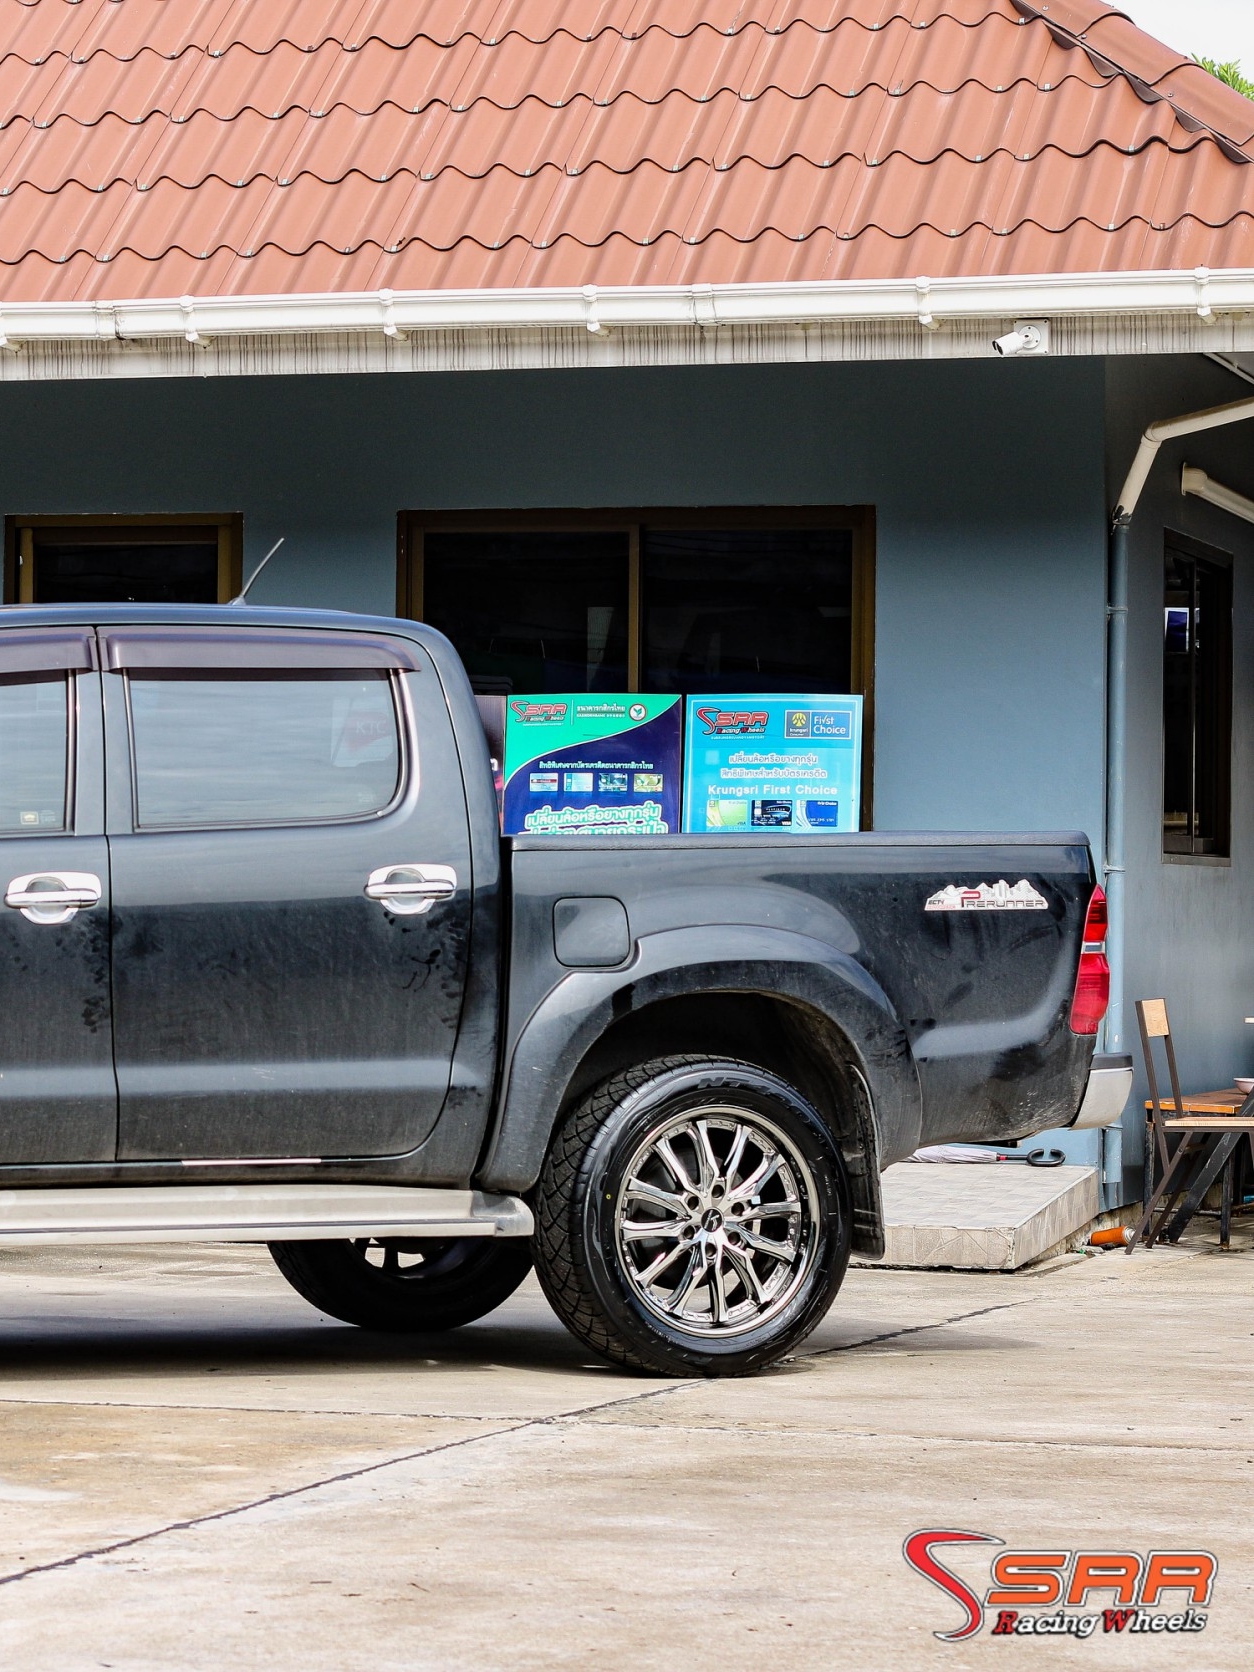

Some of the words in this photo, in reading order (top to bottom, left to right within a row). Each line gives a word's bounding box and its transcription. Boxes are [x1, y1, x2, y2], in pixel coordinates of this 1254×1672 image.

[813, 725, 846, 735] Choice
[708, 785, 758, 796] Krungsri
[763, 785, 790, 794] First
[795, 785, 838, 794] Choice
